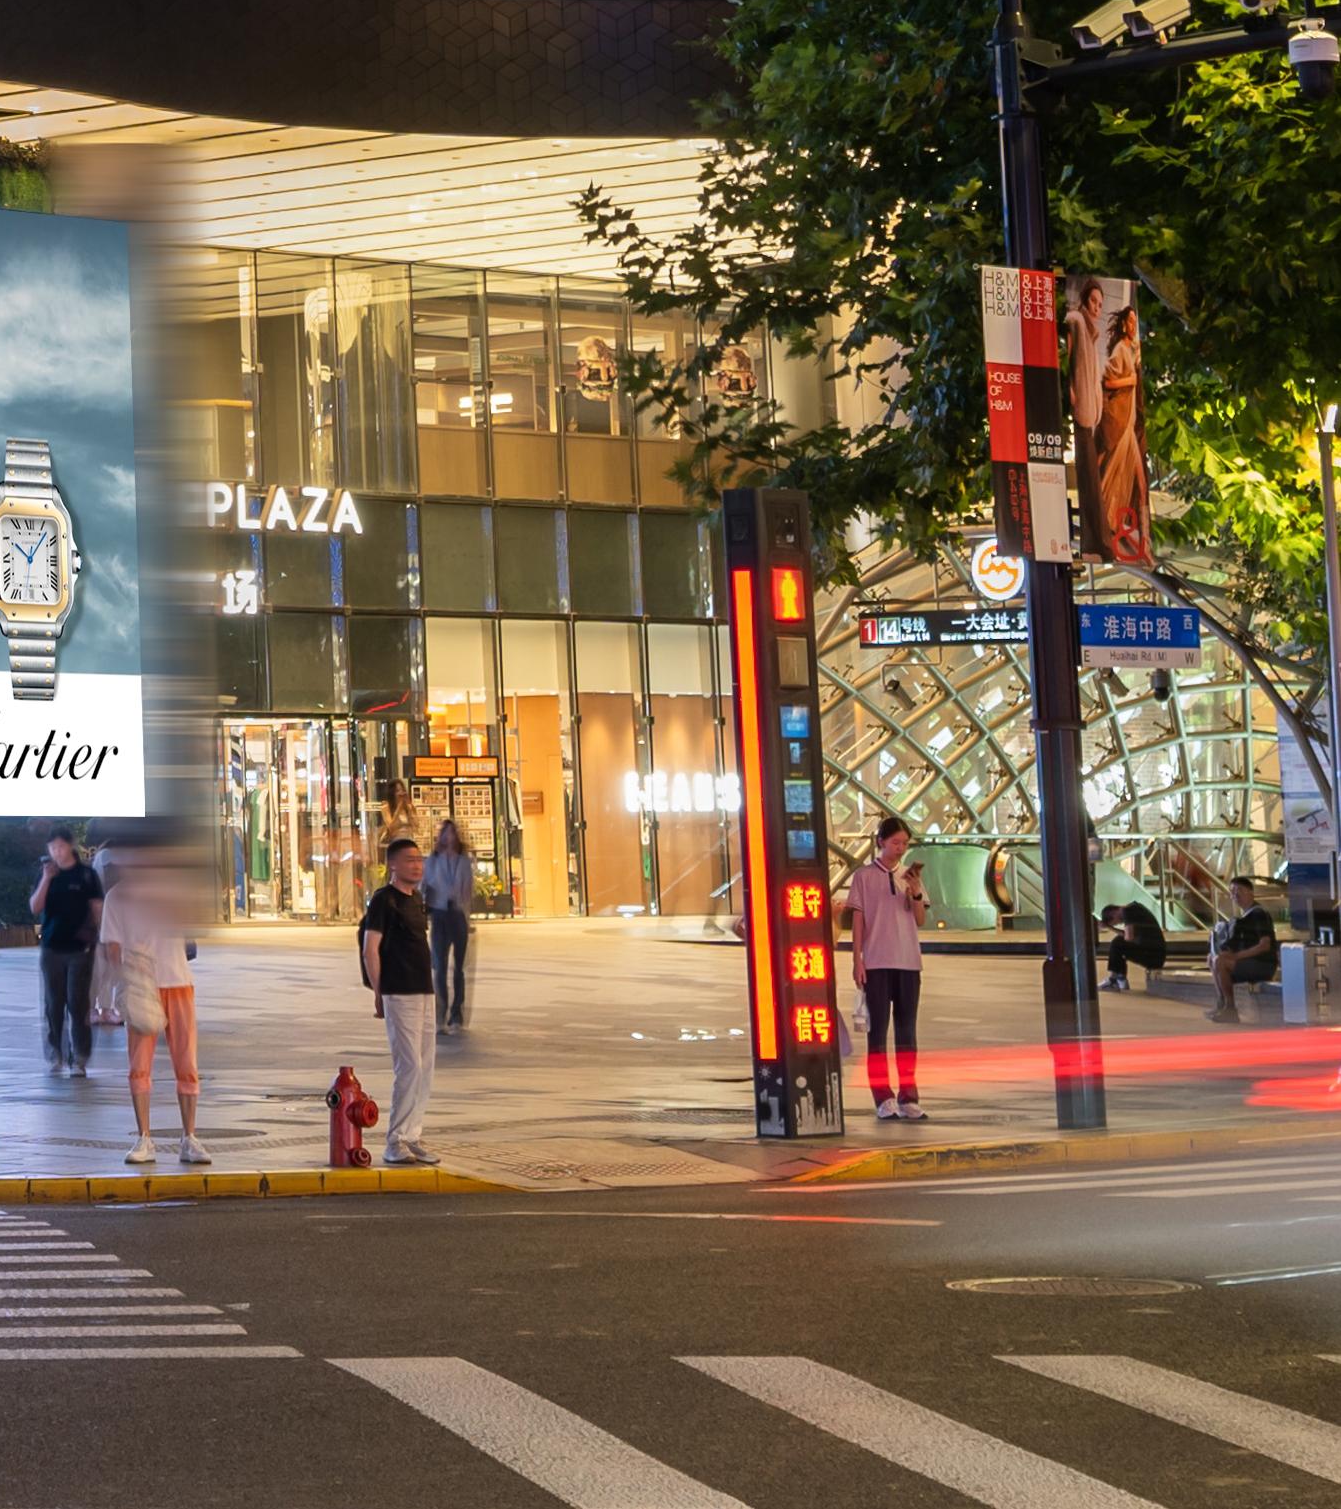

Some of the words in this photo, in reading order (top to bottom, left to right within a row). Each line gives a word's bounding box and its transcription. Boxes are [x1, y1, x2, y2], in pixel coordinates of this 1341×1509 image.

[984, 271, 1019, 287] H&M
[984, 286, 1019, 302] H&M
[985, 301, 1020, 317] H&M
[988, 371, 1022, 385] HOUSE
[989, 385, 1003, 396] OF
[990, 400, 1013, 411] H&M
[1028, 433, 1062, 446] 09/09
[206, 482, 363, 534] PLAZA
[880, 619, 900, 642] 14
[901, 617, 927, 632] 号线
[1081, 612, 1091, 628] 东
[1103, 615, 1172, 641] 淮海中路
[1183, 614, 1193, 630] 西
[1083, 650, 1091, 663] E
[1109, 651, 1138, 661] Huaihai
[1185, 652, 1195, 665] W
[789, 885, 821, 919] 遵守
[792, 947, 825, 980] 交通
[795, 1008, 830, 1043] 信号
